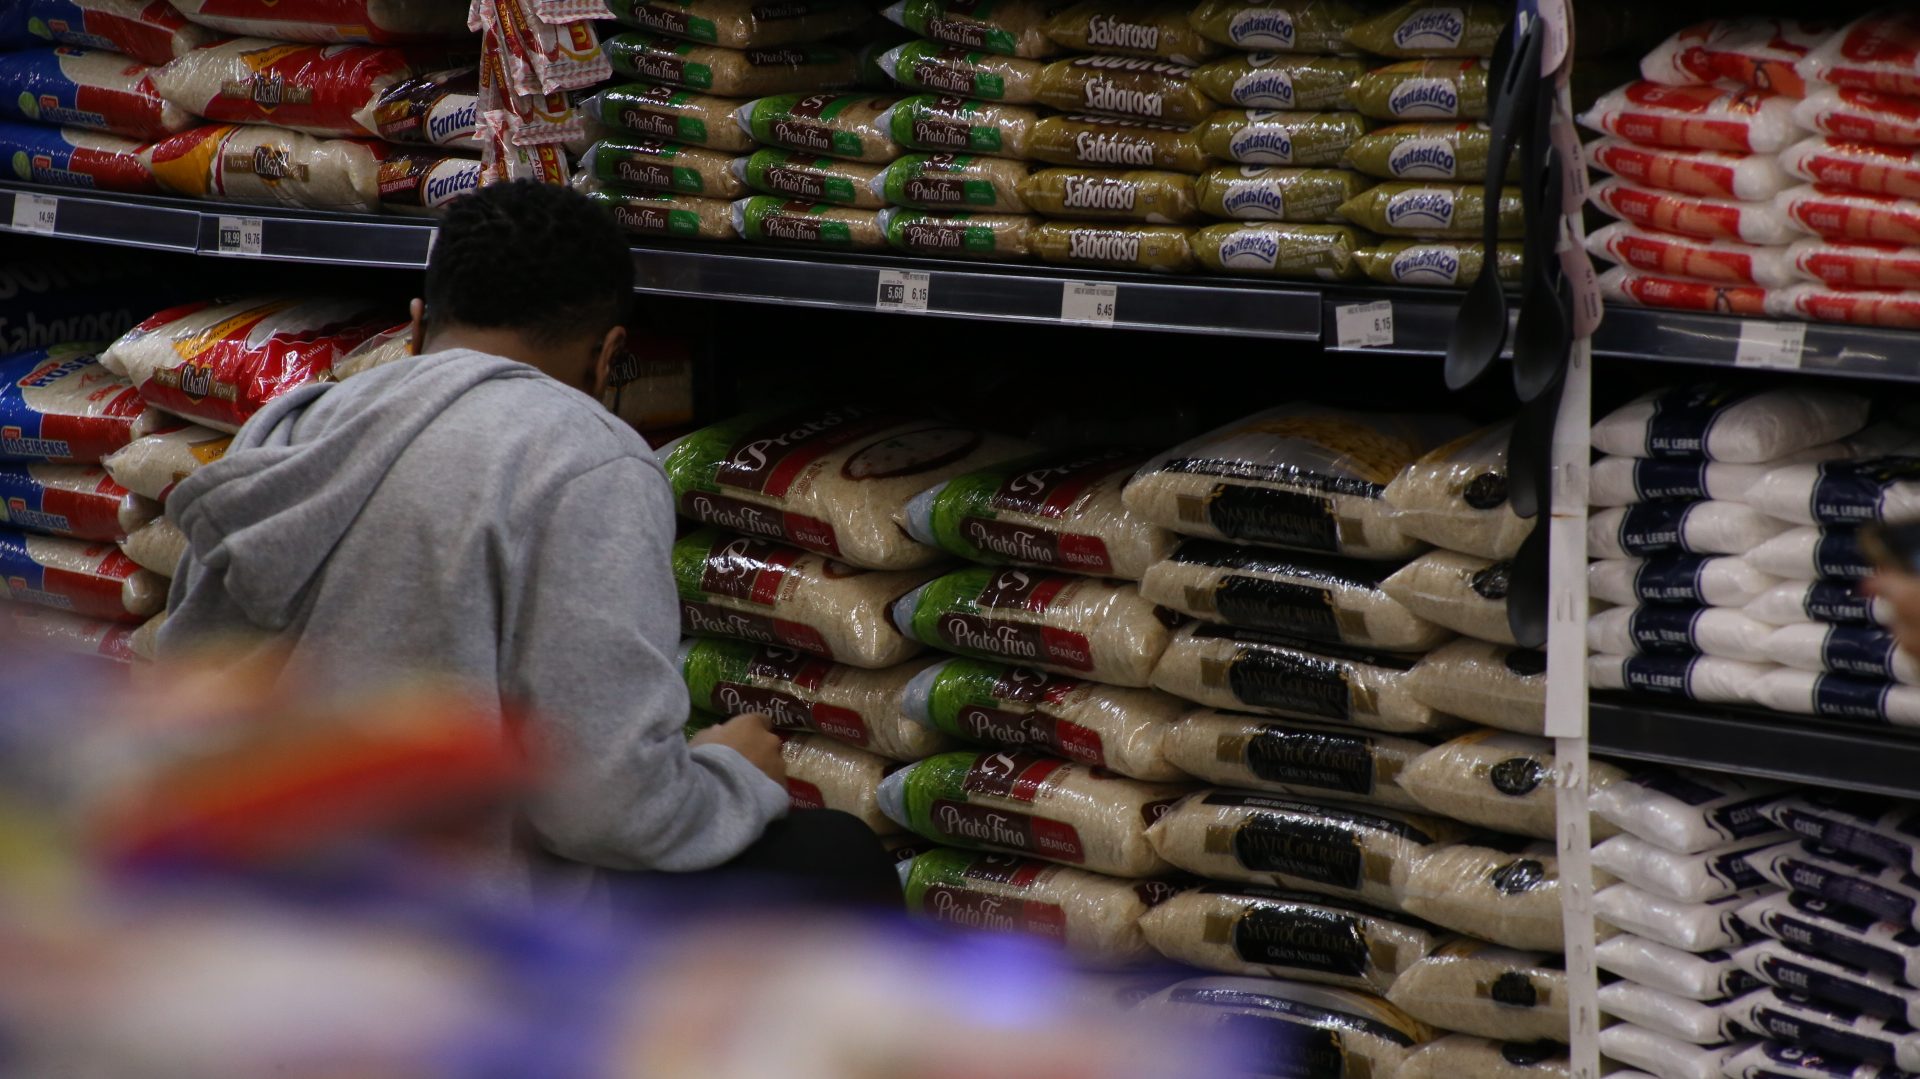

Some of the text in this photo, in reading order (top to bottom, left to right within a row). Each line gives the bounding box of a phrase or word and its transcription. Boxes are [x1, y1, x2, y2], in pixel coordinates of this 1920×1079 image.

[1088, 14, 1159, 49] Saboroso
[1085, 77, 1162, 117] Saboroso
[1076, 132, 1154, 166] Saboroso
[1064, 176, 1135, 210] Saboroso
[1069, 229, 1141, 261] Saboroso
[911, 287, 927, 301] 6,15
[1096, 303, 1113, 316] 6,45
[1374, 316, 1391, 332] 6,15
[1652, 437, 1700, 451] SAL LEBRE
[1819, 503, 1841, 516] SAL
[796, 530, 830, 547] BRANC
[1627, 531, 1677, 545] SAL LEBRE
[1642, 587, 1663, 599] SAL
[1637, 629, 1660, 643] SAL
[1630, 671, 1683, 687] SAL LEBRE
